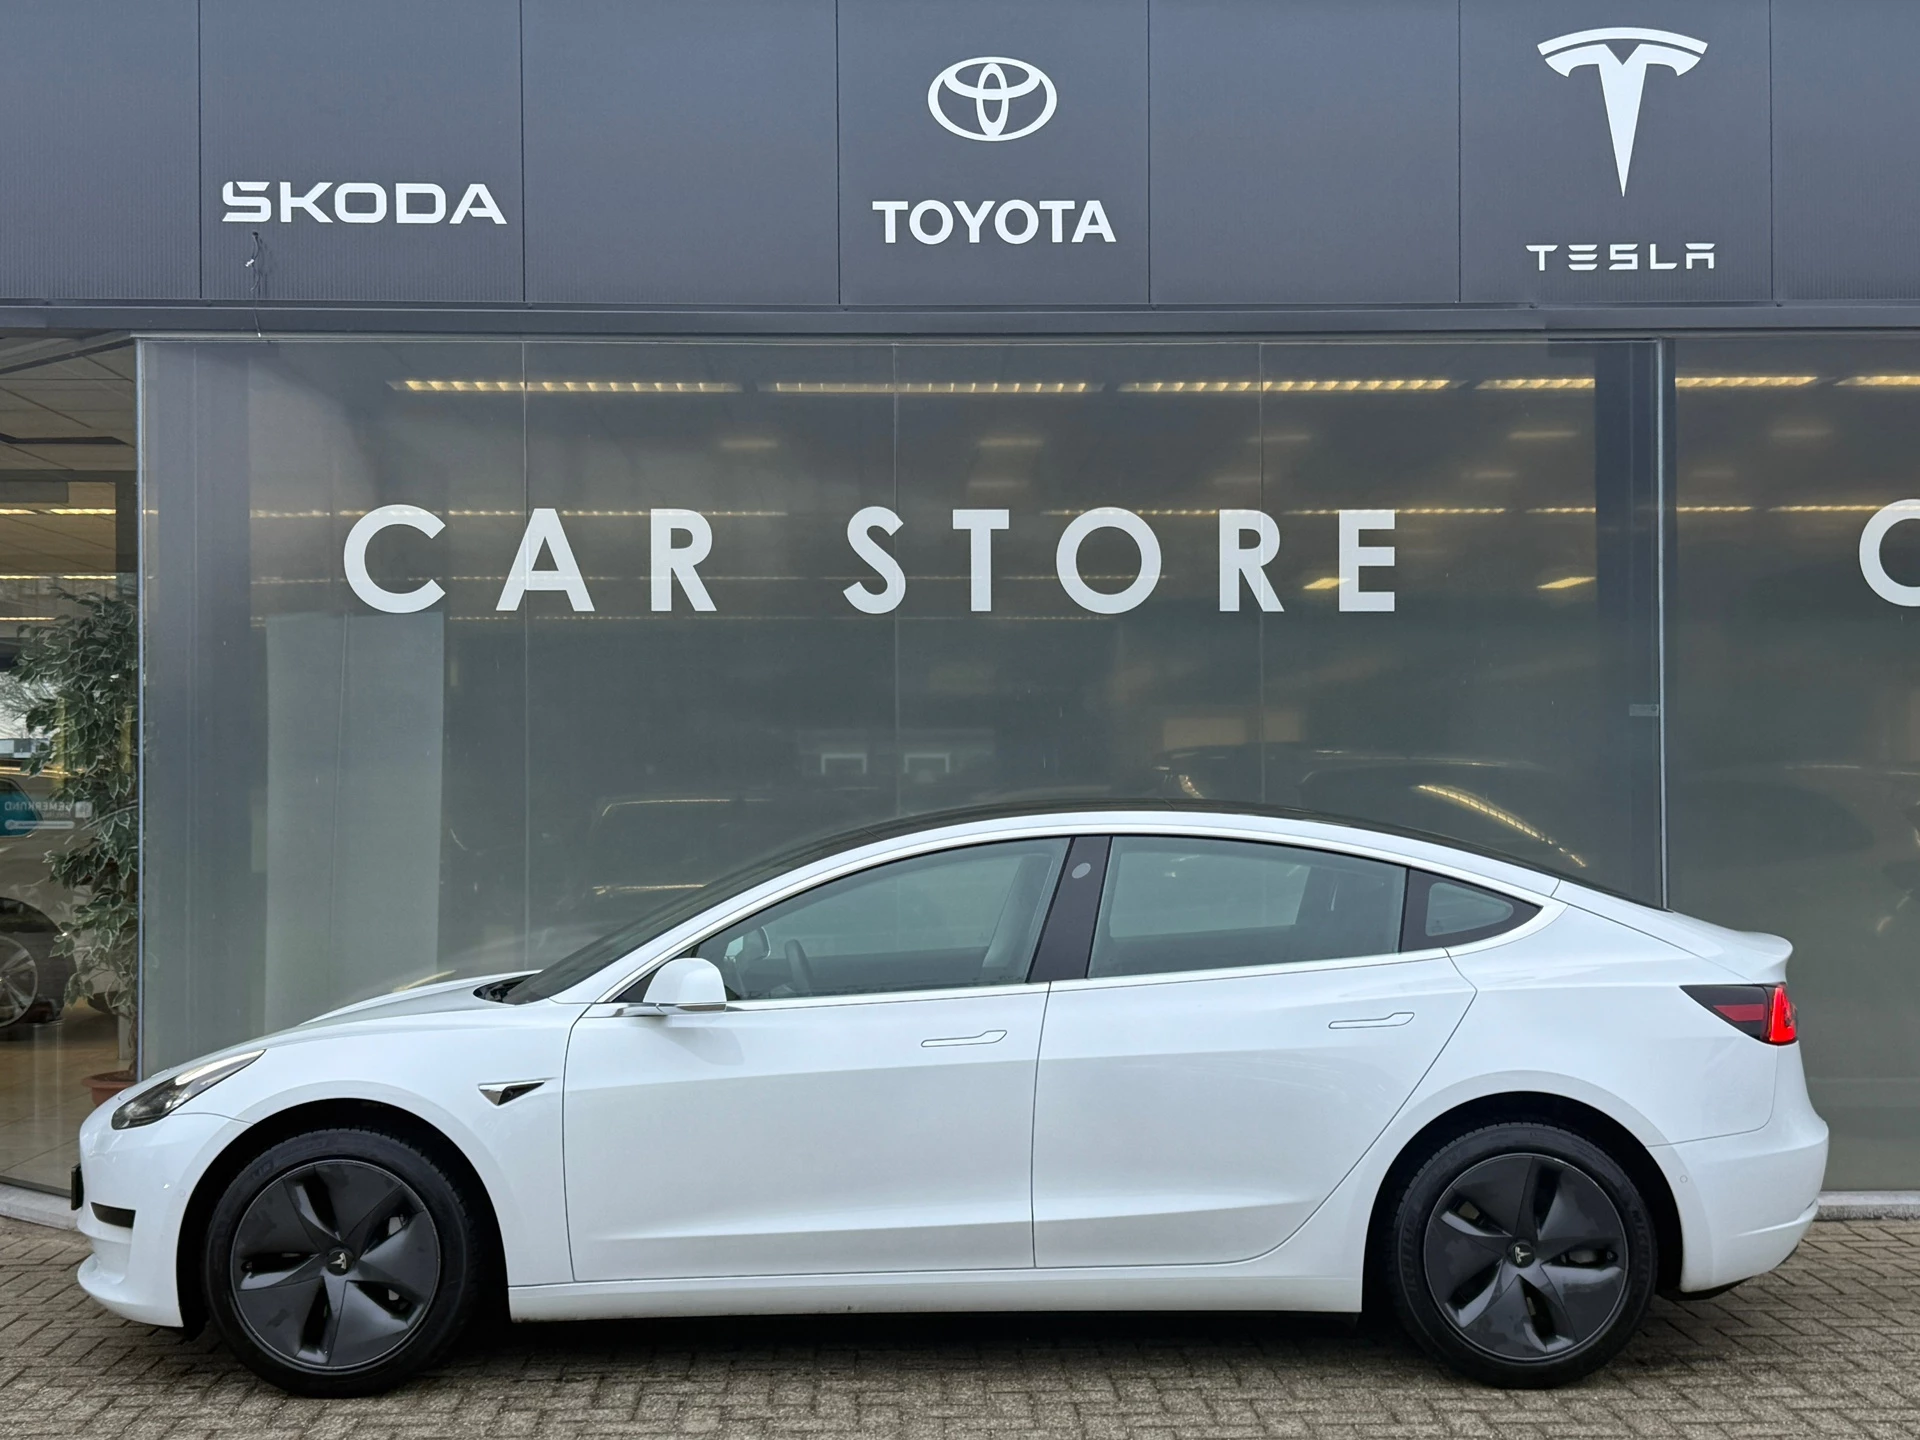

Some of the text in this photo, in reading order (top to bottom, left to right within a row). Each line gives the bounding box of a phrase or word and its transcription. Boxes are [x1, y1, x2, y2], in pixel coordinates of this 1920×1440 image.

[872, 199, 1116, 245] TOYOTA
[1526, 243, 1717, 271] TESLA
[344, 504, 1396, 614] CAR STORE
